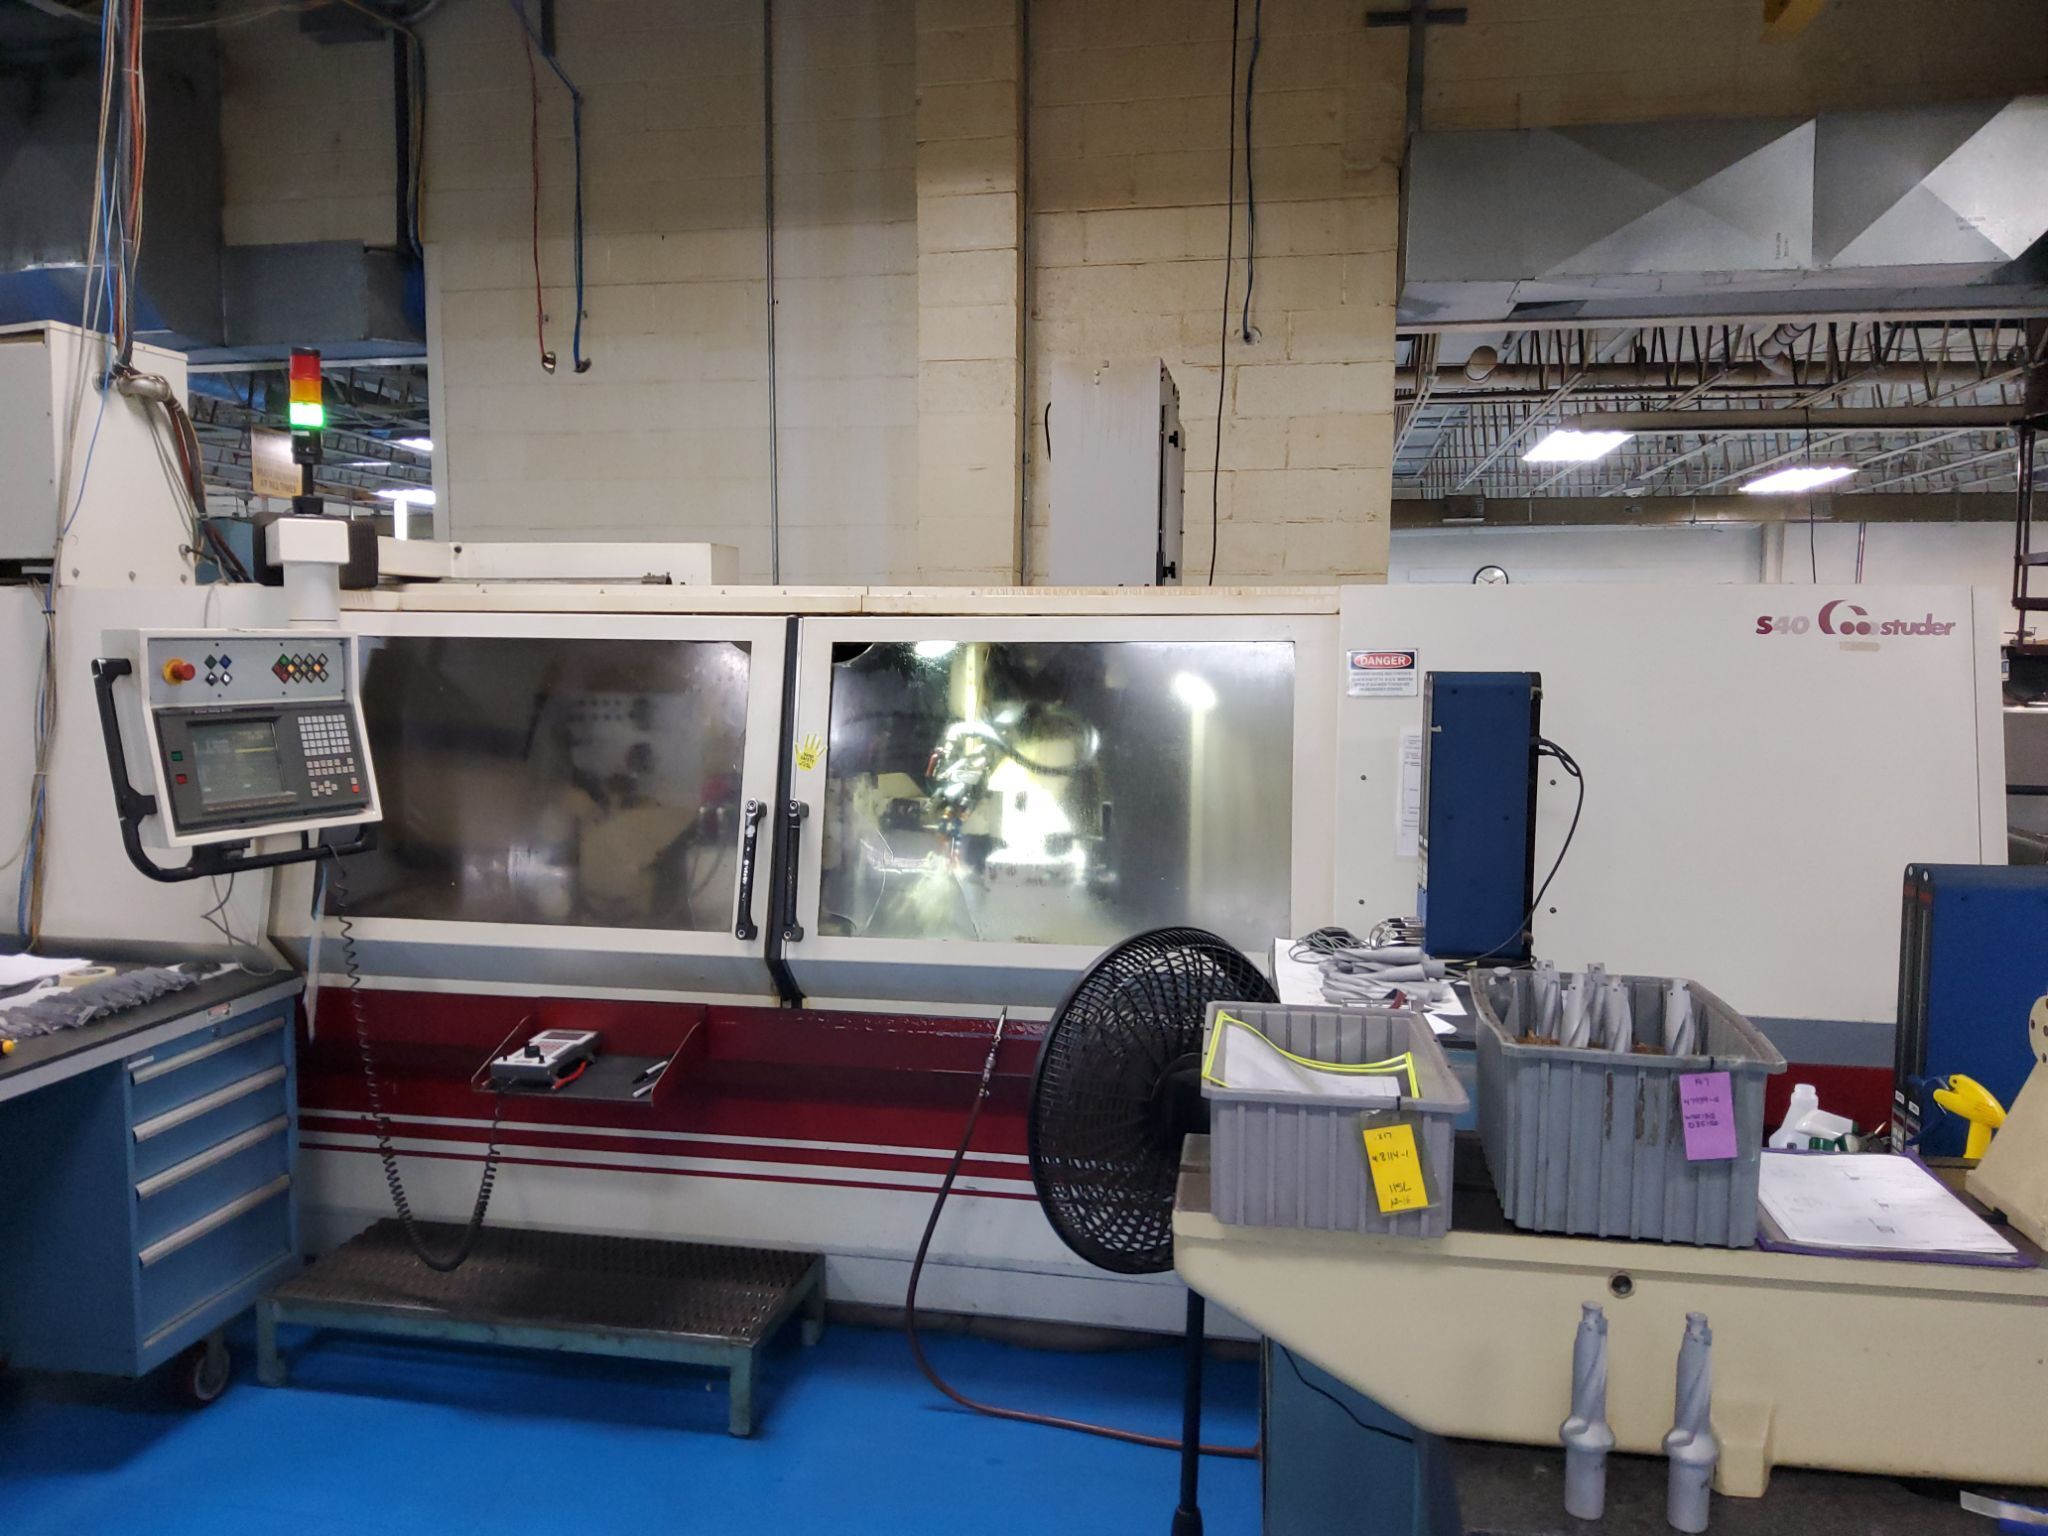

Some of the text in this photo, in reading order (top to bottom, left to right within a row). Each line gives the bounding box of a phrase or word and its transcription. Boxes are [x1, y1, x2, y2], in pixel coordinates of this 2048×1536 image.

[1755, 615, 1810, 635] S40
[1880, 613, 1957, 636] studer
[1360, 656, 1406, 666] DANGER
